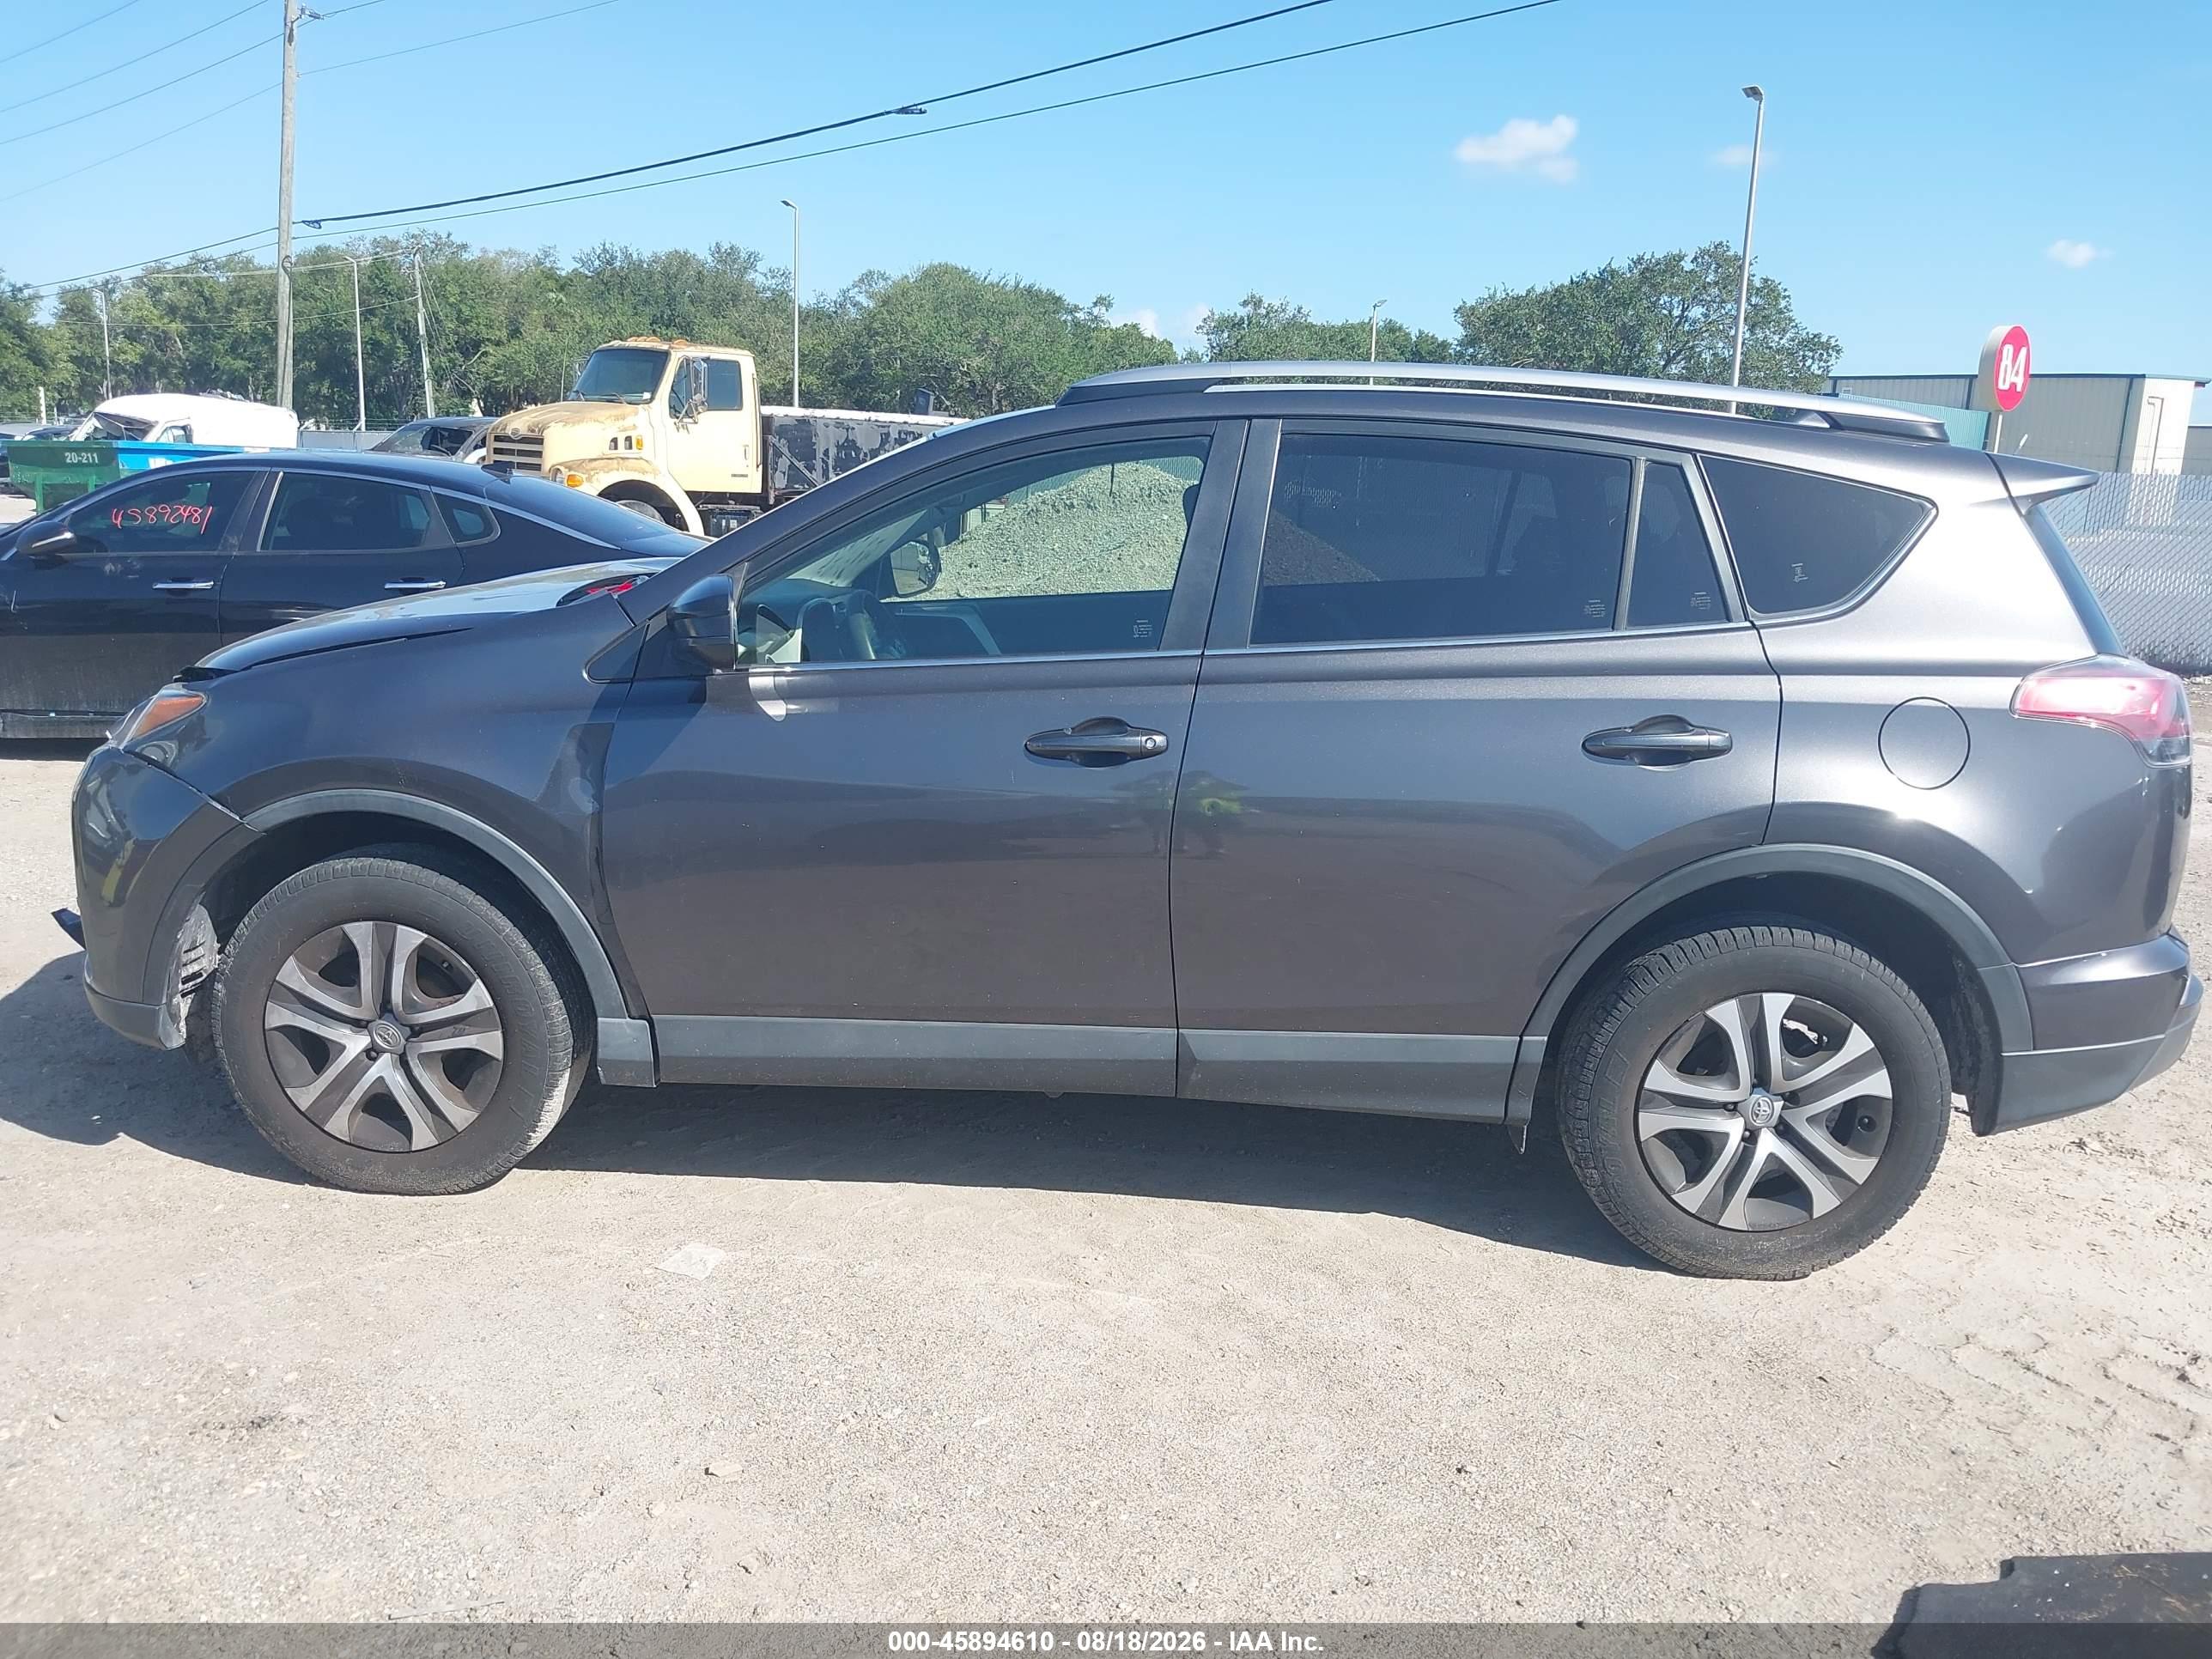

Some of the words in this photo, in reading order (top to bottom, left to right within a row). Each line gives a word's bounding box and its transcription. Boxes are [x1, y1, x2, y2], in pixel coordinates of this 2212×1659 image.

[1997, 343, 2027, 392] 84
[64, 452, 99, 464] 20-211
[112, 504, 213, 534] 45892481
